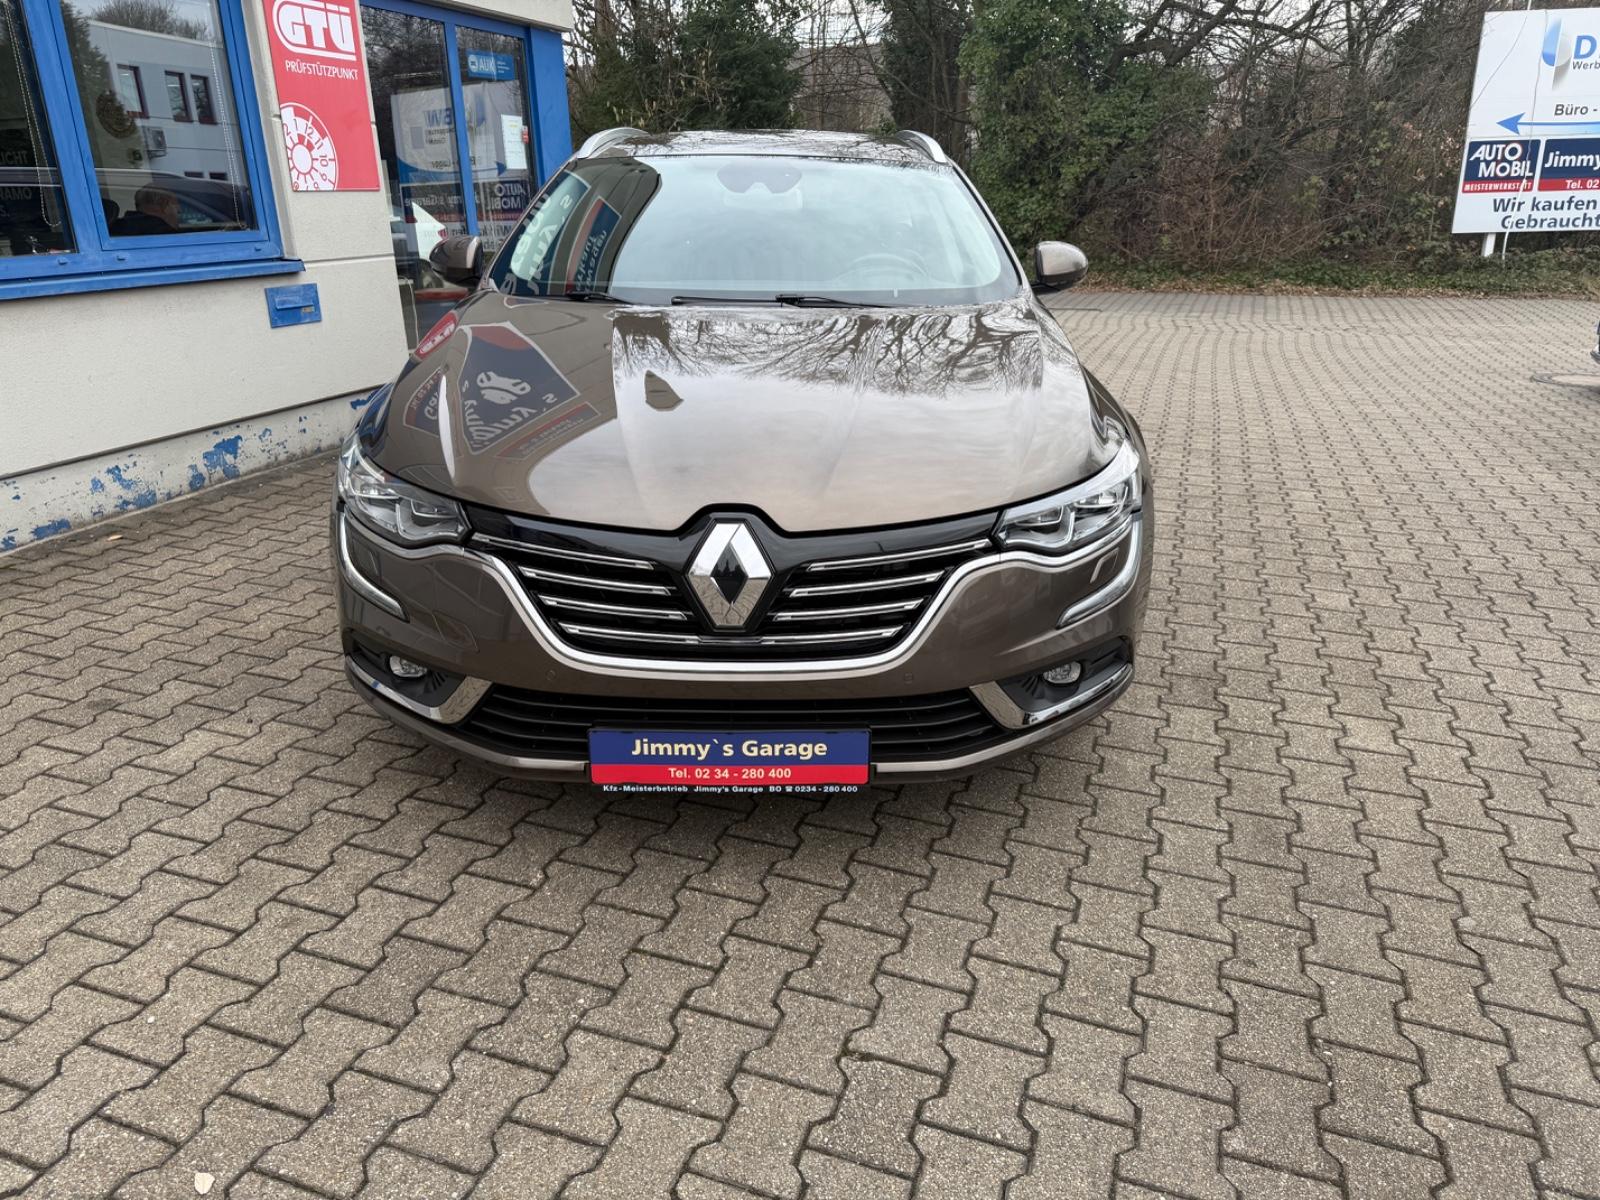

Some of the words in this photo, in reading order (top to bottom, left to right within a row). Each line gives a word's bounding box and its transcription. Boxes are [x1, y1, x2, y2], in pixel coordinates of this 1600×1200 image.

[278, 3, 355, 53] GTÜ
[285, 59, 359, 80] PRÜFSTÜTZPUNKT
[1554, 104, 1588, 116] Büro
[1470, 143, 1522, 161] AUTO
[1544, 151, 1600, 170] Jimmy
[1478, 161, 1533, 177] MOBIL
[1464, 182, 1531, 191] MEISTERWERKSTTT
[1566, 180, 1583, 189] Tel.
[1586, 180, 1600, 188] 02
[1493, 197, 1525, 212] Wir
[1531, 196, 1597, 212] kaufen
[742, 740, 828, 760] Garage
[668, 768, 691, 778] Tel.
[695, 768, 710, 779] 02
[714, 768, 730, 779] 34
[742, 768, 765, 779] 280
[768, 768, 792, 778] 400
[694, 785, 729, 793] Jimmy's
